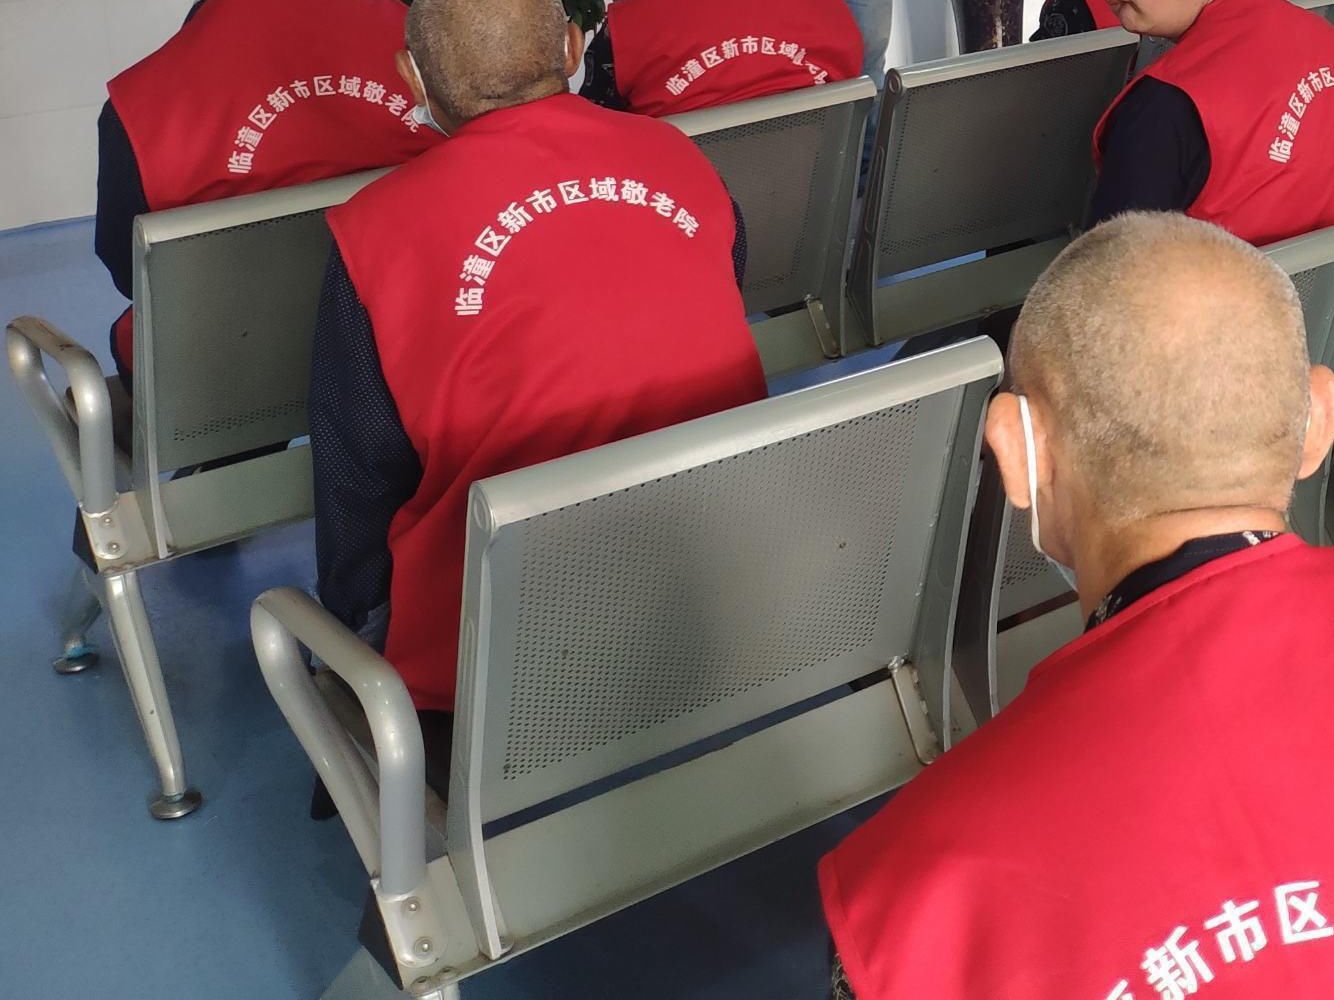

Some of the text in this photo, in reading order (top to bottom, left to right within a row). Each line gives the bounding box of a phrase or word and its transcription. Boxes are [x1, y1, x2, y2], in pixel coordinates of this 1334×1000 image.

[454, 176, 700, 316] 临潼区新市区域敬老院
